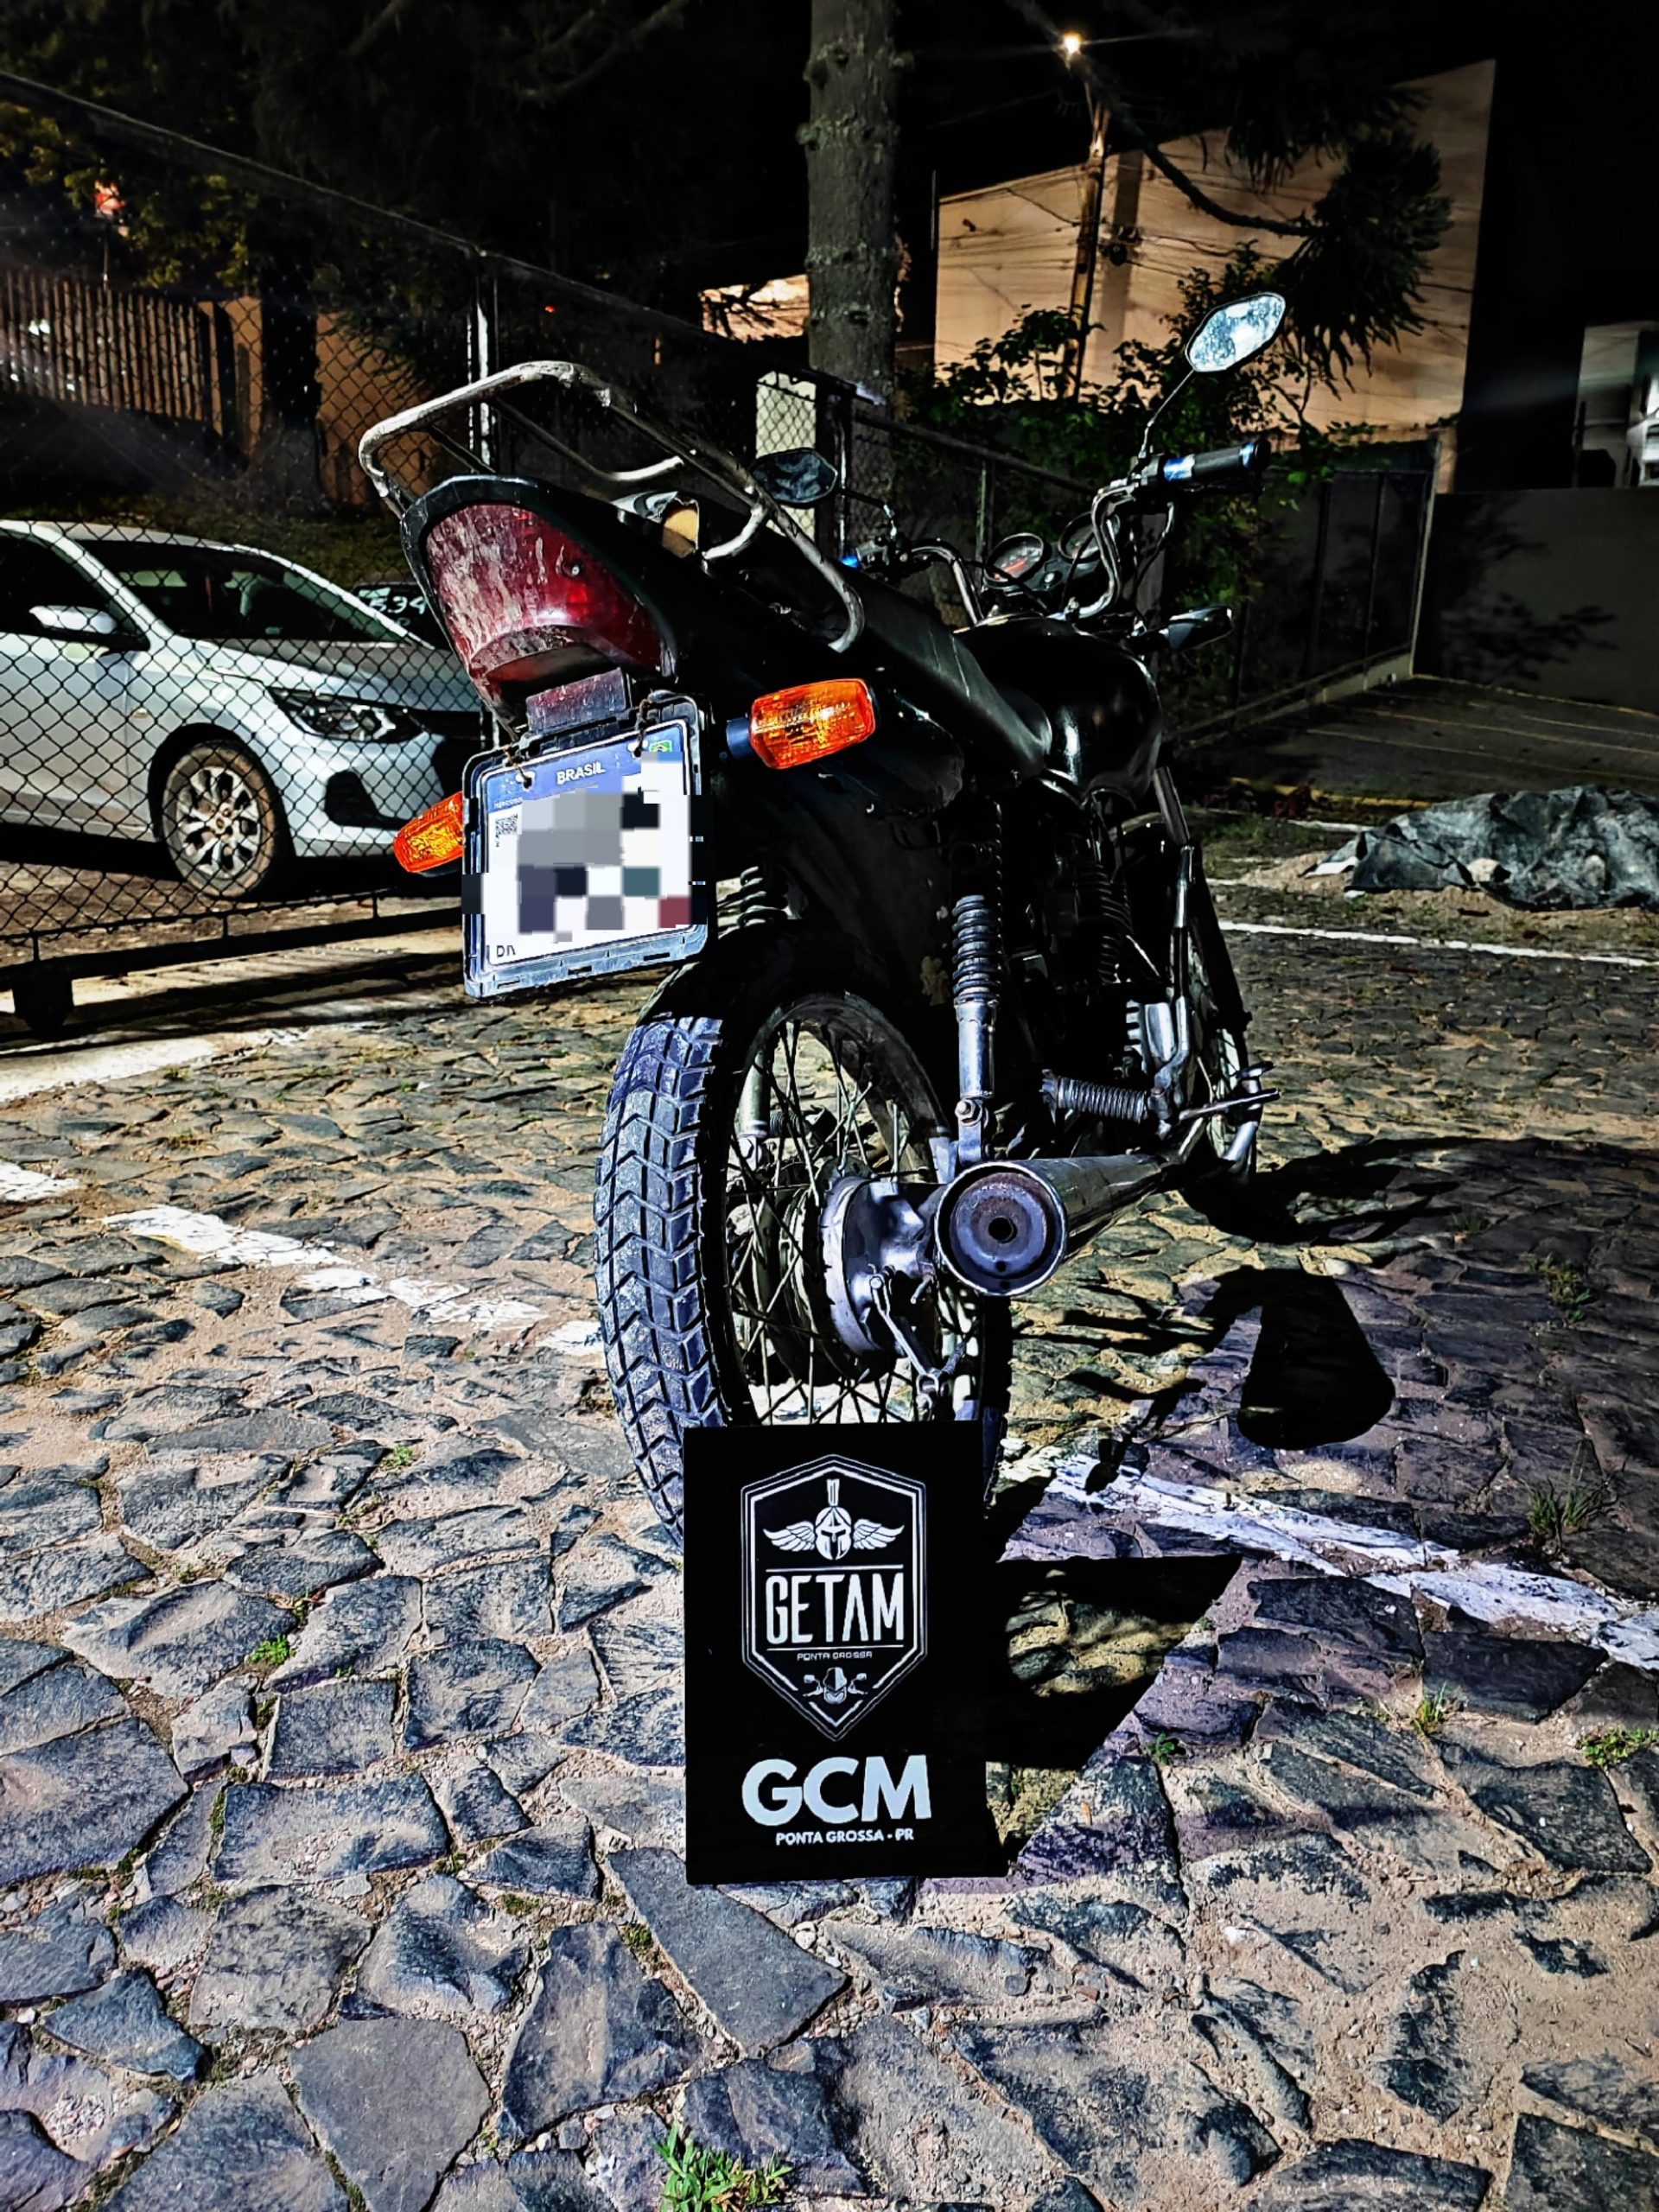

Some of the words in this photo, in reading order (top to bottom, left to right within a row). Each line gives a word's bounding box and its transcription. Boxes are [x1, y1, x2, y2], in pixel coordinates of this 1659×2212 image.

[556, 761, 607, 785] BRASIL
[766, 1573, 905, 1644] GETAM
[797, 1652, 830, 1662] PONTA
[741, 1754, 932, 1827] GCM
[775, 1831, 823, 1846] PONTA
[826, 1828, 885, 1844] GROSSA
[895, 1827, 914, 1841] PR
